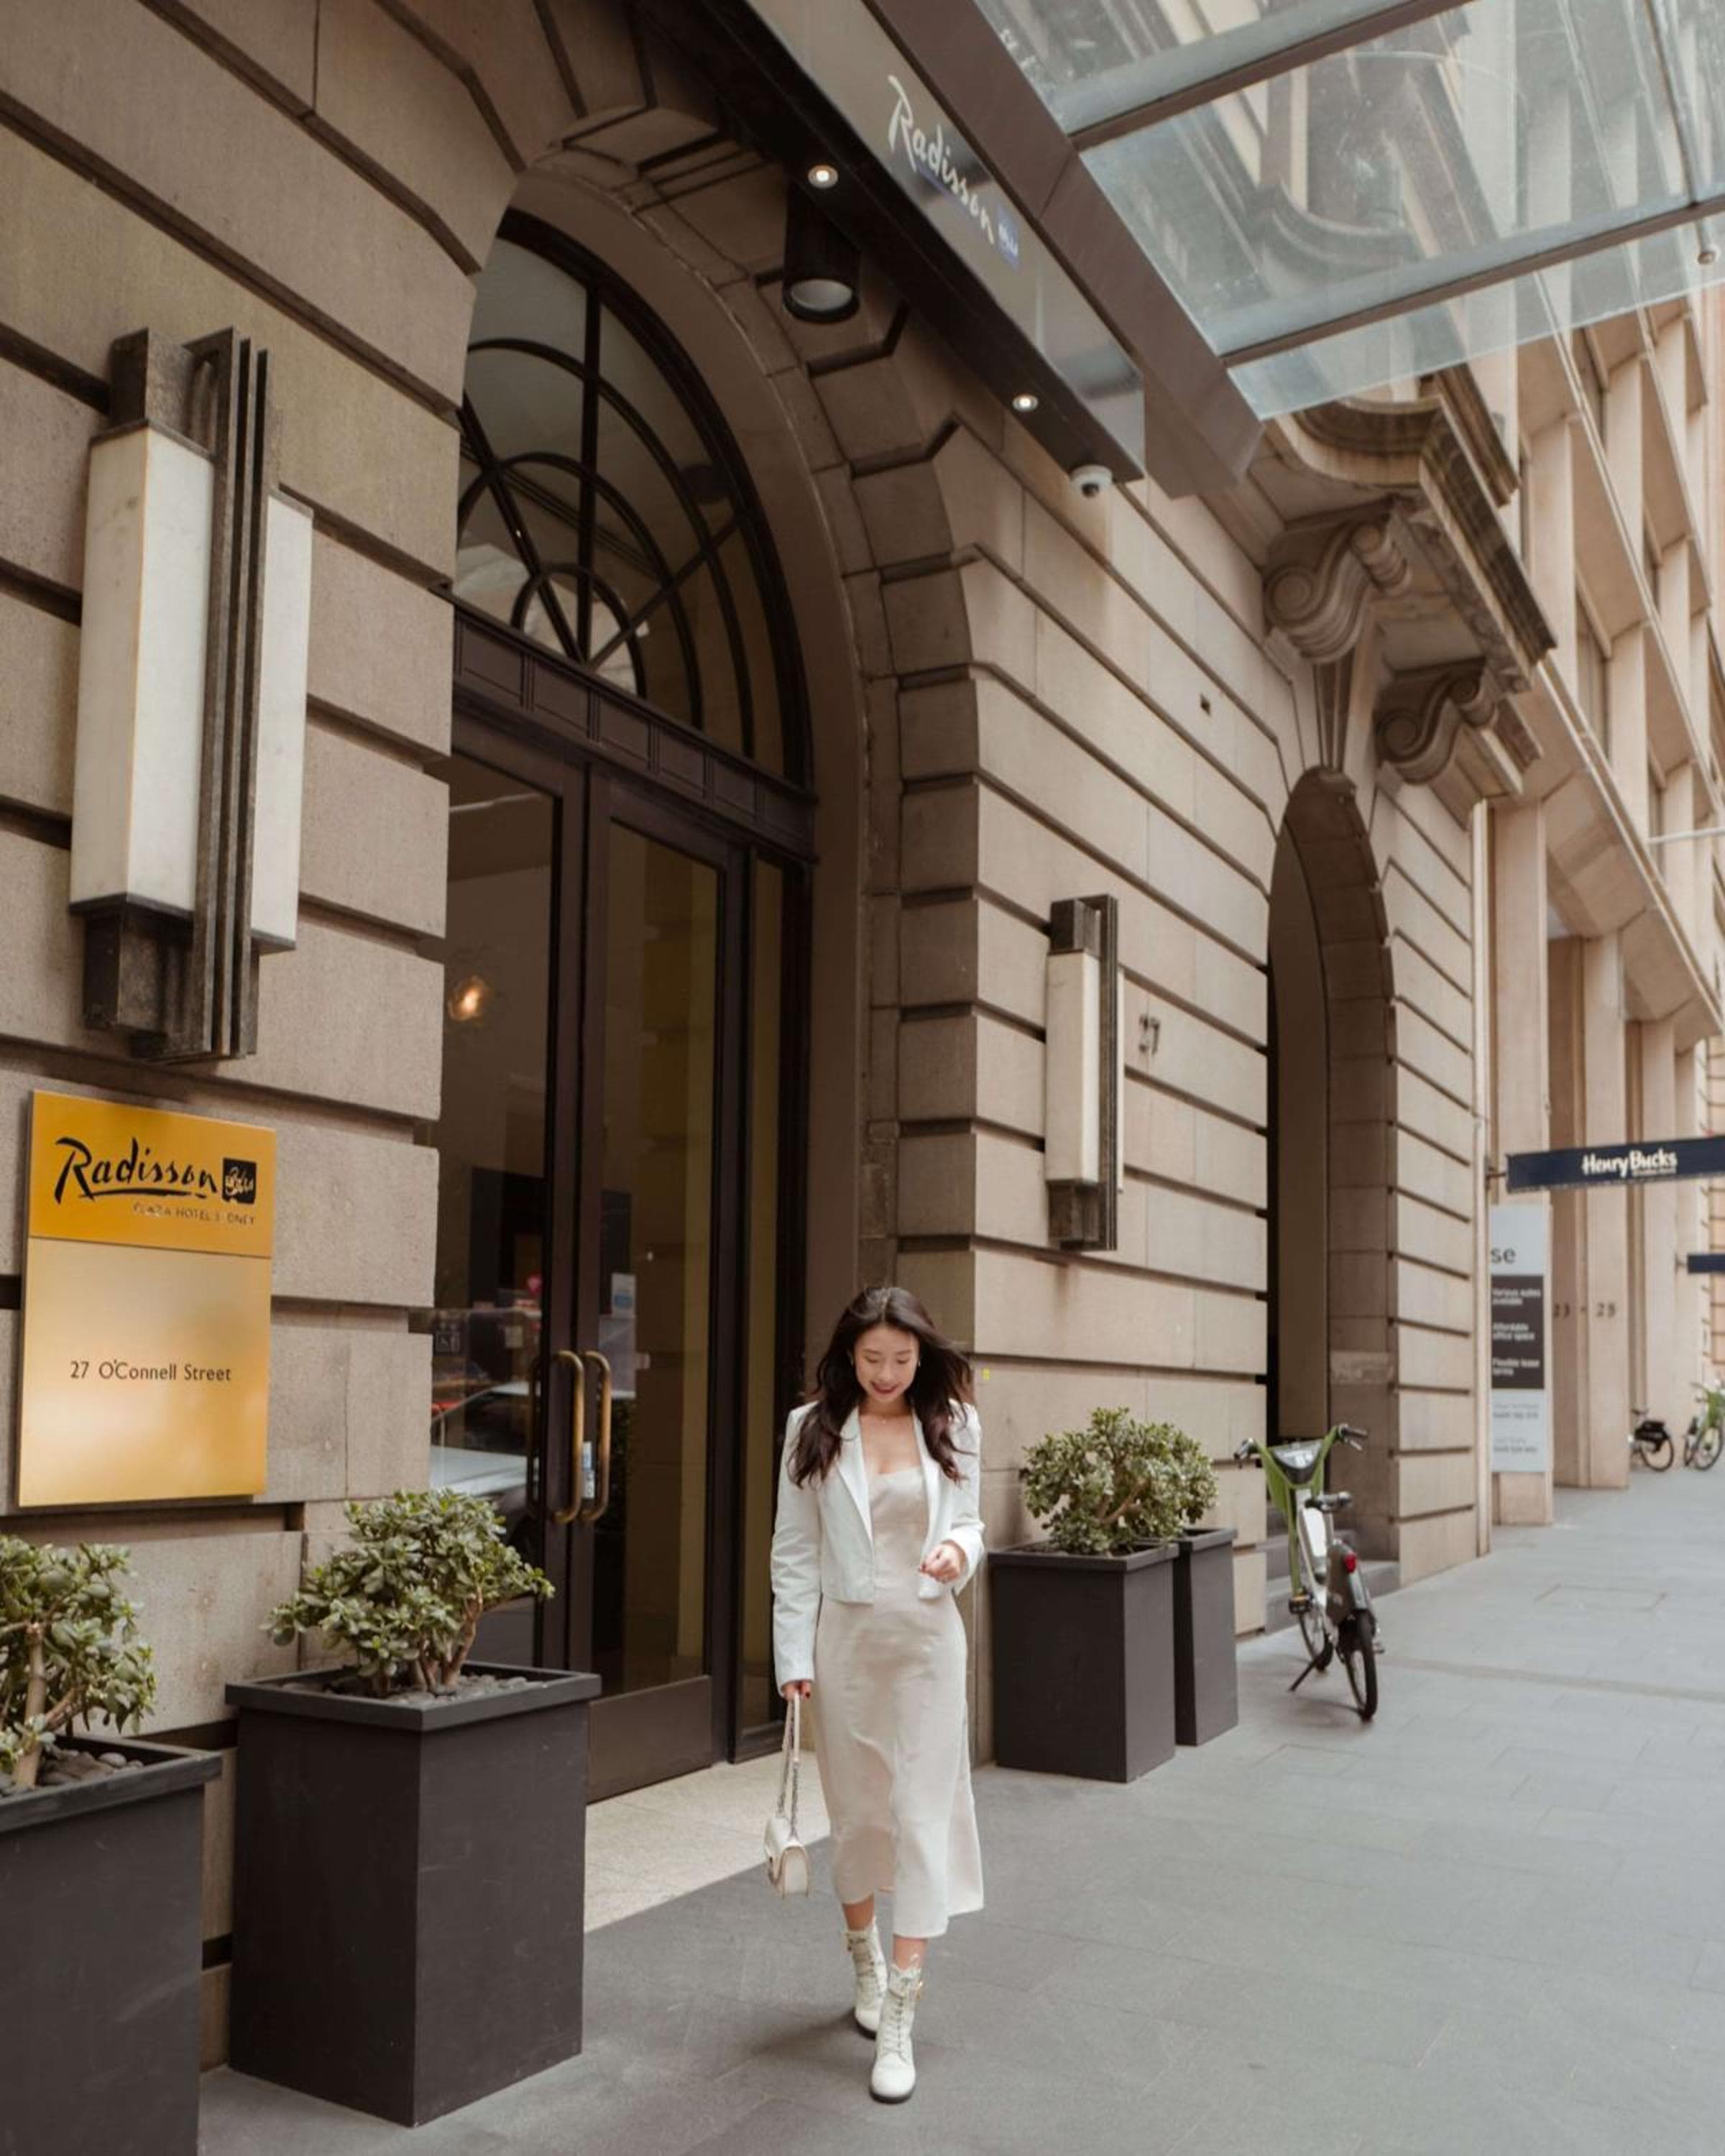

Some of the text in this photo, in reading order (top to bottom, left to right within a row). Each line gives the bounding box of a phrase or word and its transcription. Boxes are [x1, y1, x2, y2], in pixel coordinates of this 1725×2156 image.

[887, 74, 994, 246] Radisson
[1138, 1013, 1161, 1056] 27
[55, 1136, 218, 1205] Radisson
[175, 1207, 210, 1221] HOTEL
[70, 1359, 231, 1381] 27 O'Connell Street
